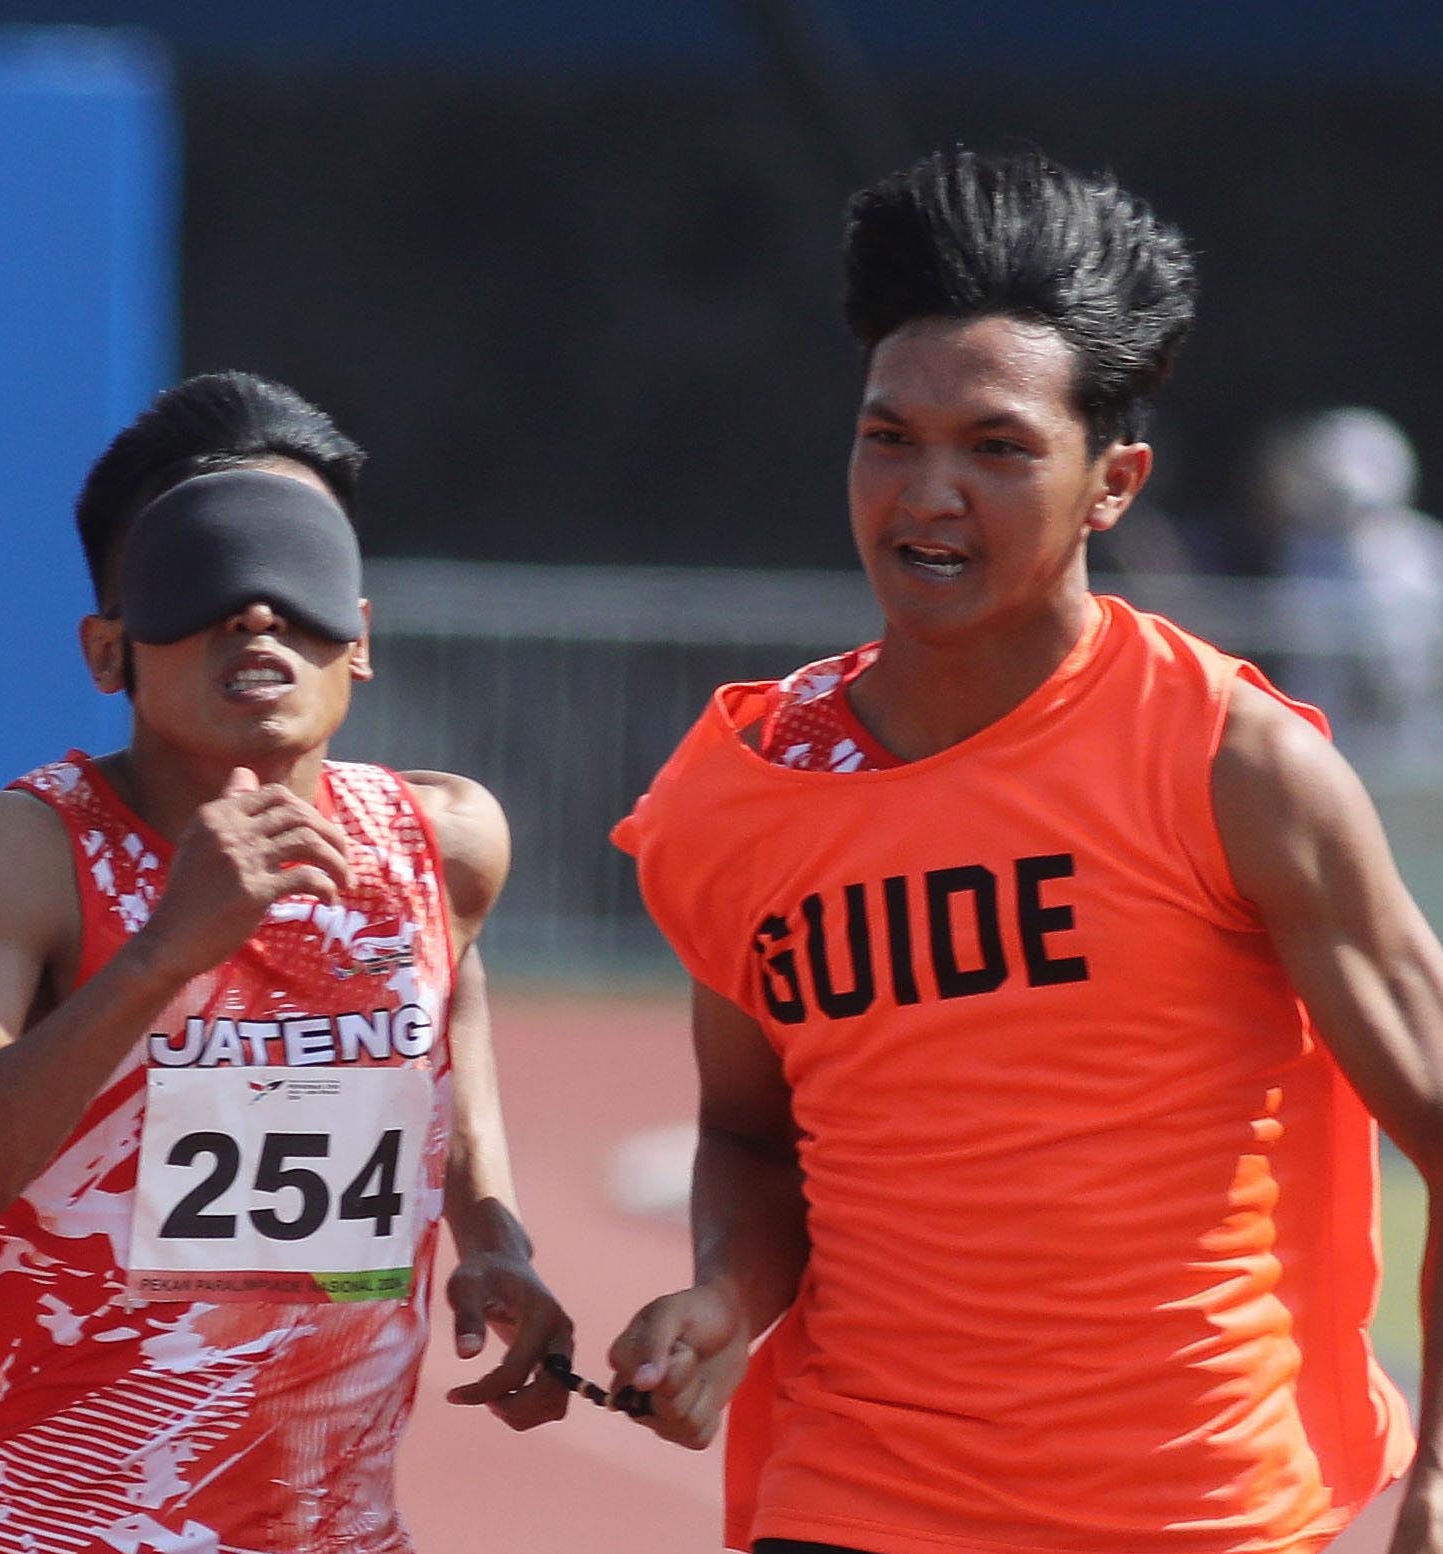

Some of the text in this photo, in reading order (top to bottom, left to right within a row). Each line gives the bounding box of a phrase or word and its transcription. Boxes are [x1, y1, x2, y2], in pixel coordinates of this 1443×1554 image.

[753, 853, 1089, 1025] GUIDE
[148, 1003, 434, 1066] JATENG
[158, 1129, 404, 1241] 254
